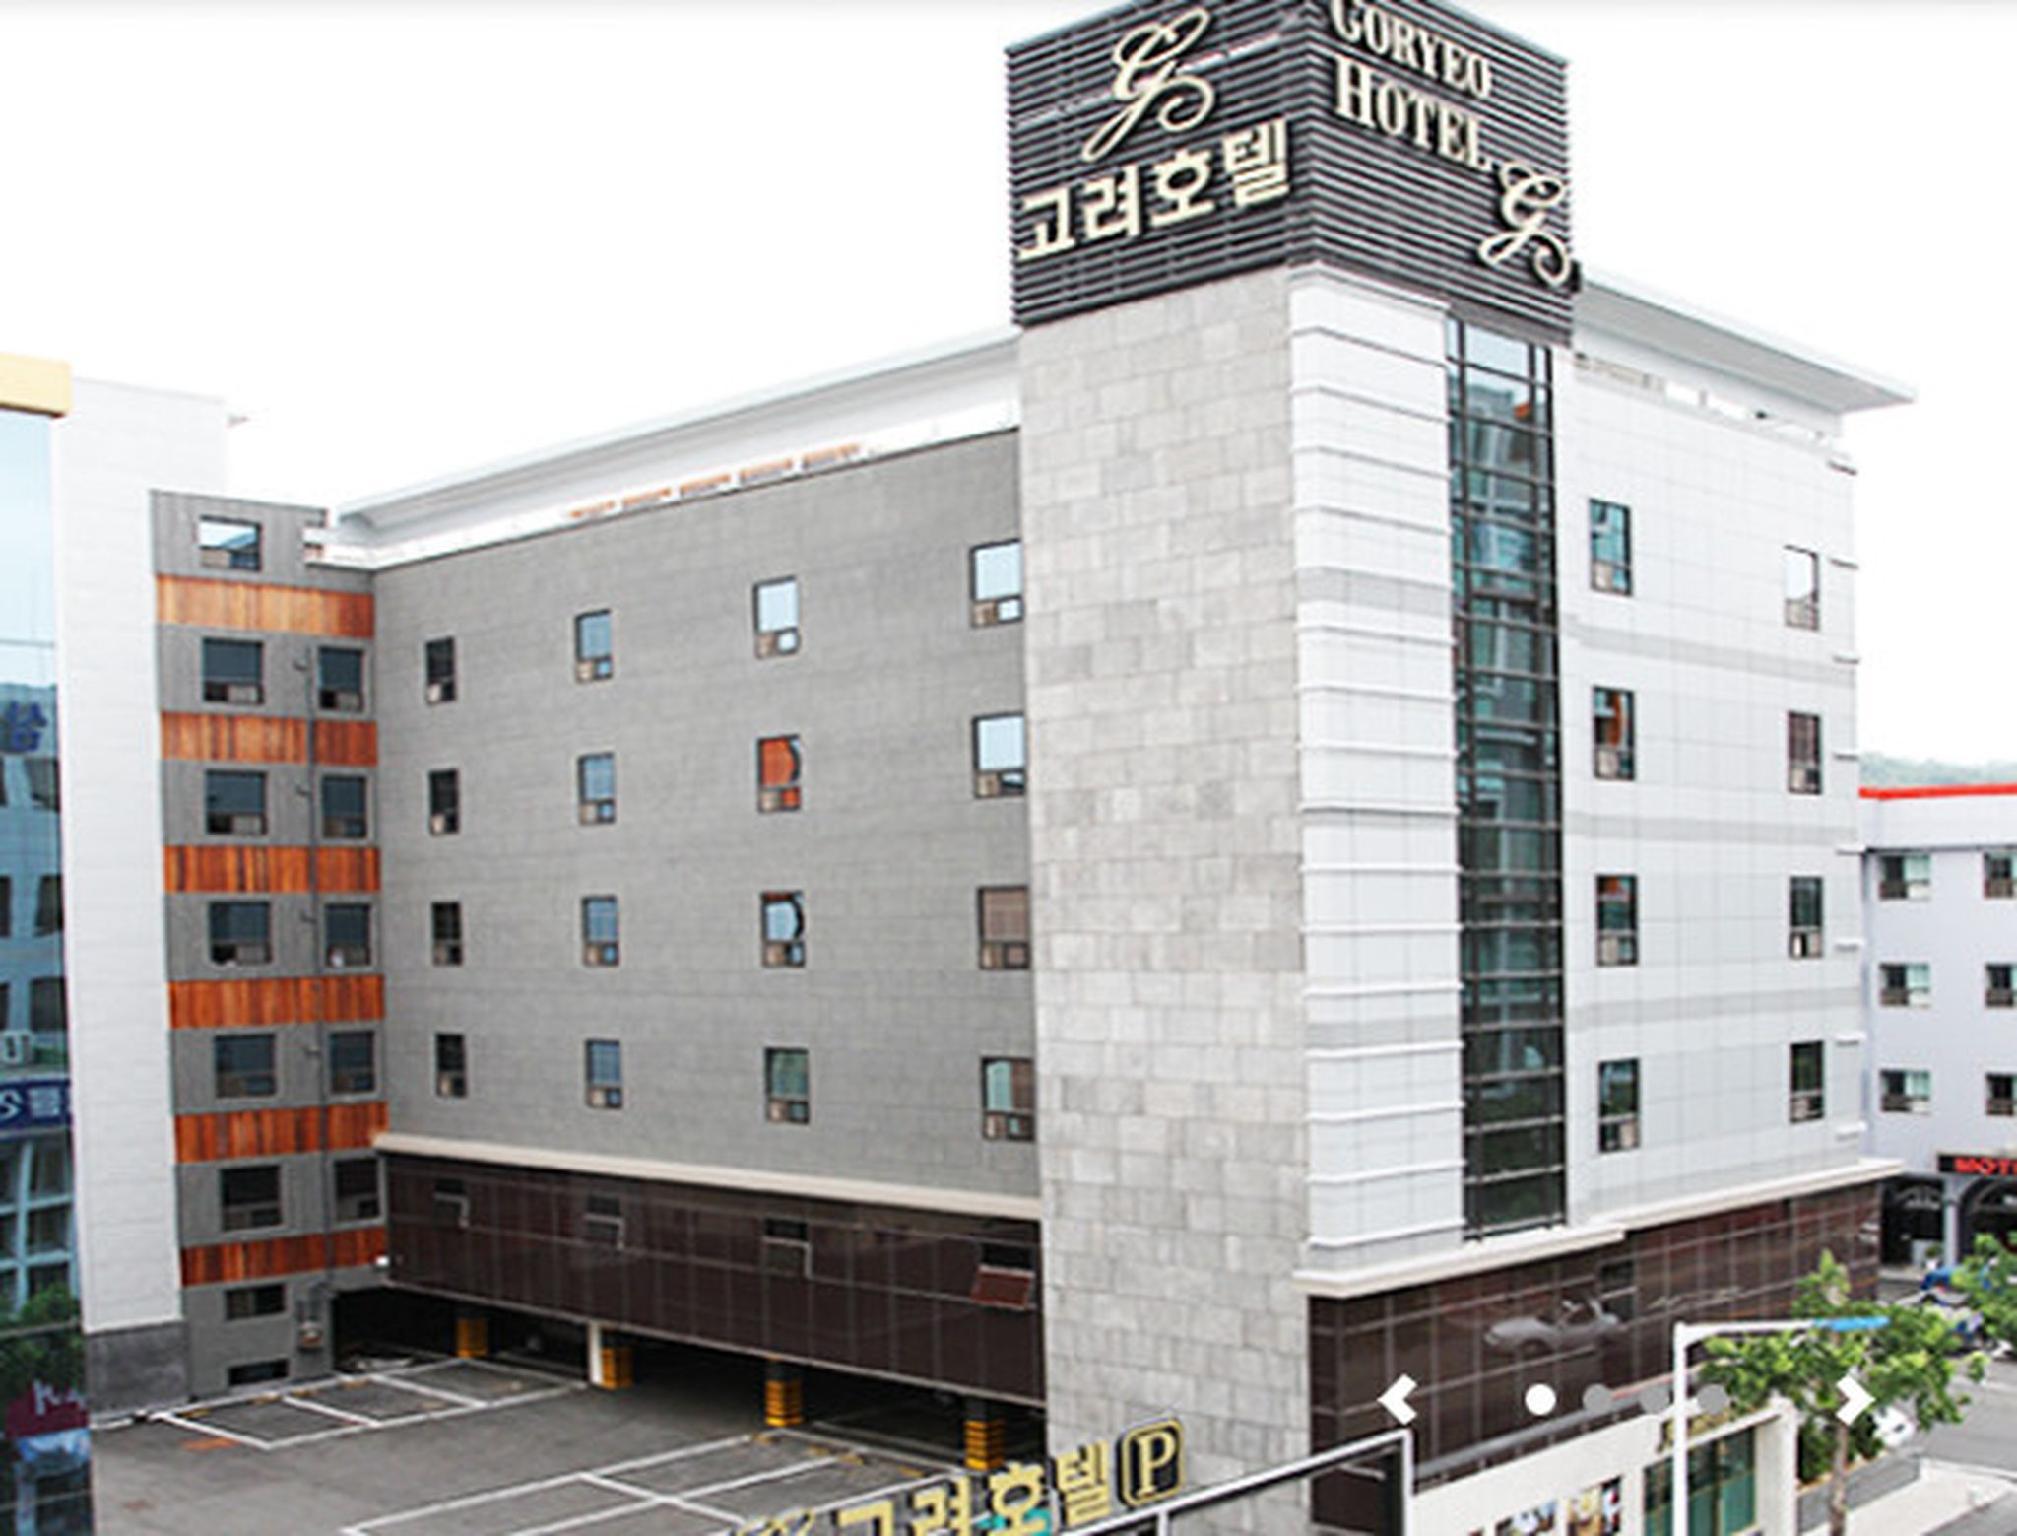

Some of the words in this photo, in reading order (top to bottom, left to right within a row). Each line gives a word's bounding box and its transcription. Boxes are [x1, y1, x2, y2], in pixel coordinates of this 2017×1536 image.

[1331, 0, 1492, 99] GORYEO
[1333, 55, 1494, 171] HOTEL
[1018, 118, 1290, 262] 고려호텔
[1954, 1156, 2017, 1176] MOT
